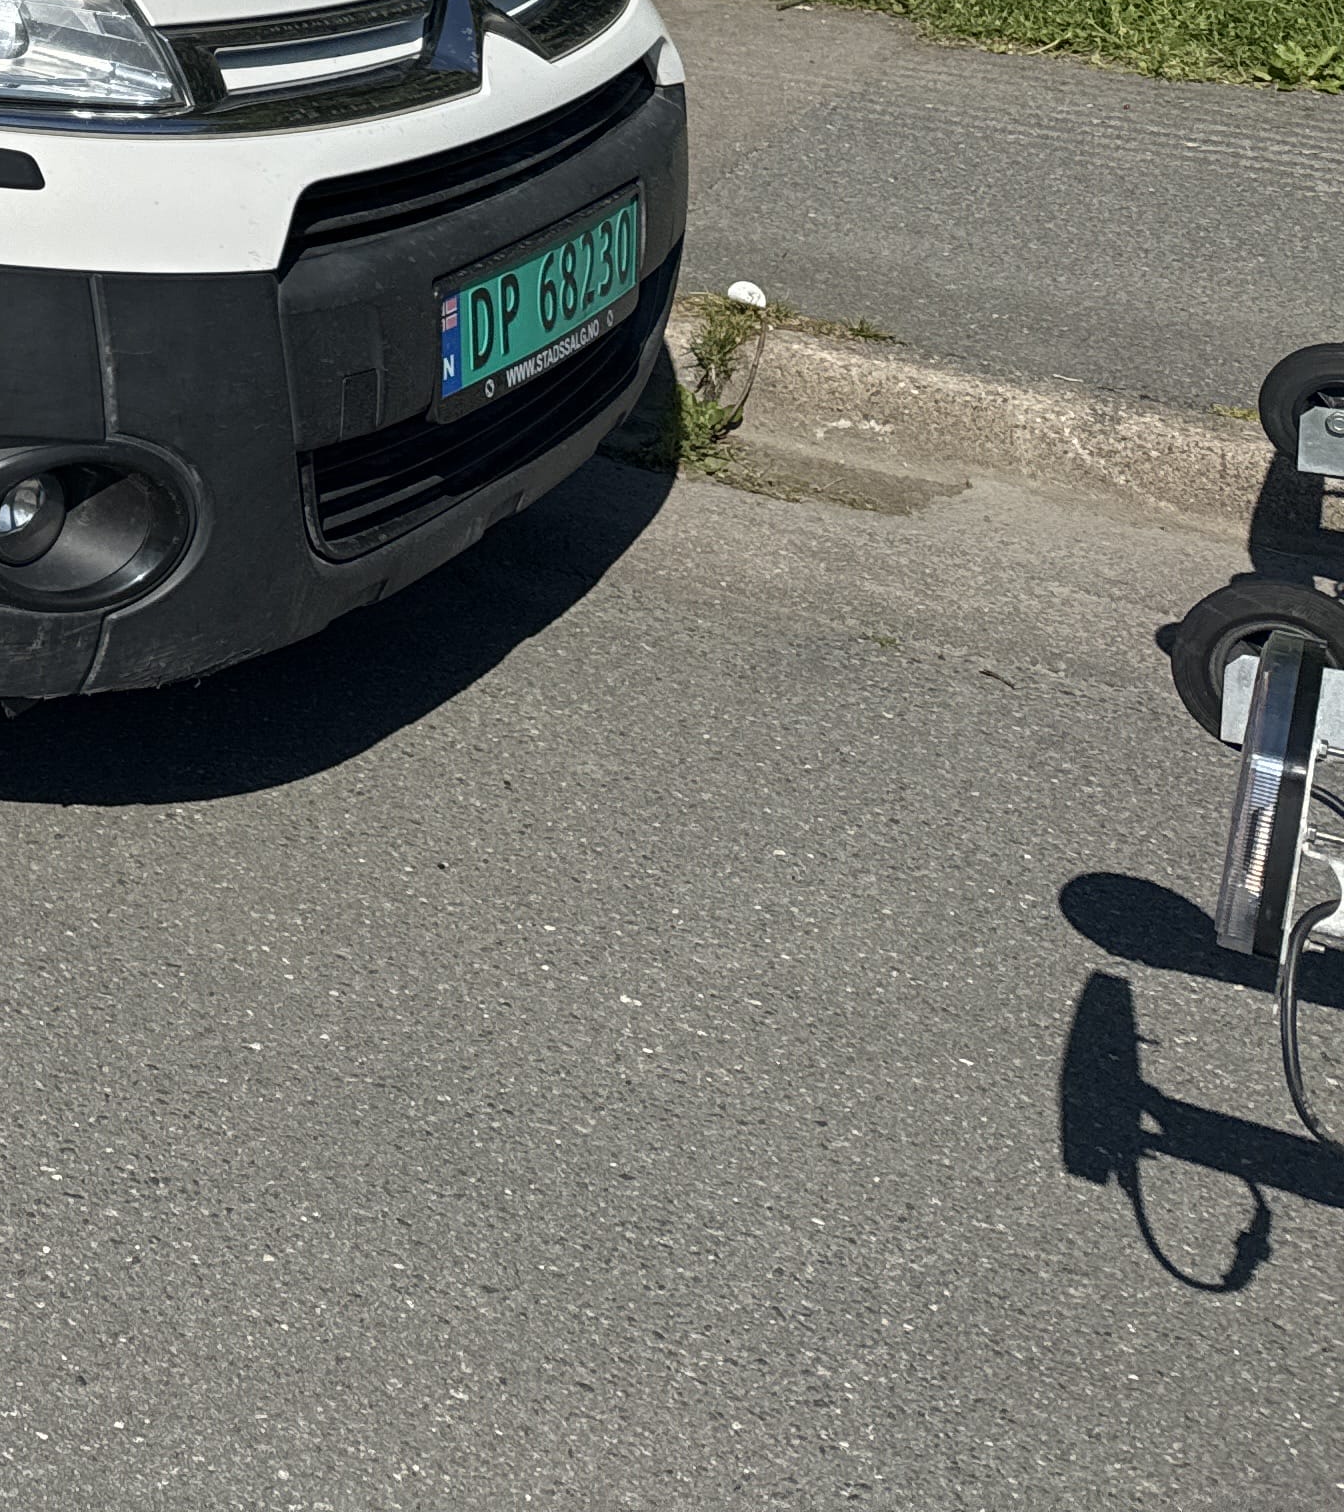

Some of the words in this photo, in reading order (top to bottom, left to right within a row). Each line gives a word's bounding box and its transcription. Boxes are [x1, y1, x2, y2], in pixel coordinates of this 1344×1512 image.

[469, 272, 520, 371] DP
[537, 209, 631, 332] 68230
[443, 354, 455, 381] N
[506, 319, 599, 388] WWW.STADSSALG.NO
